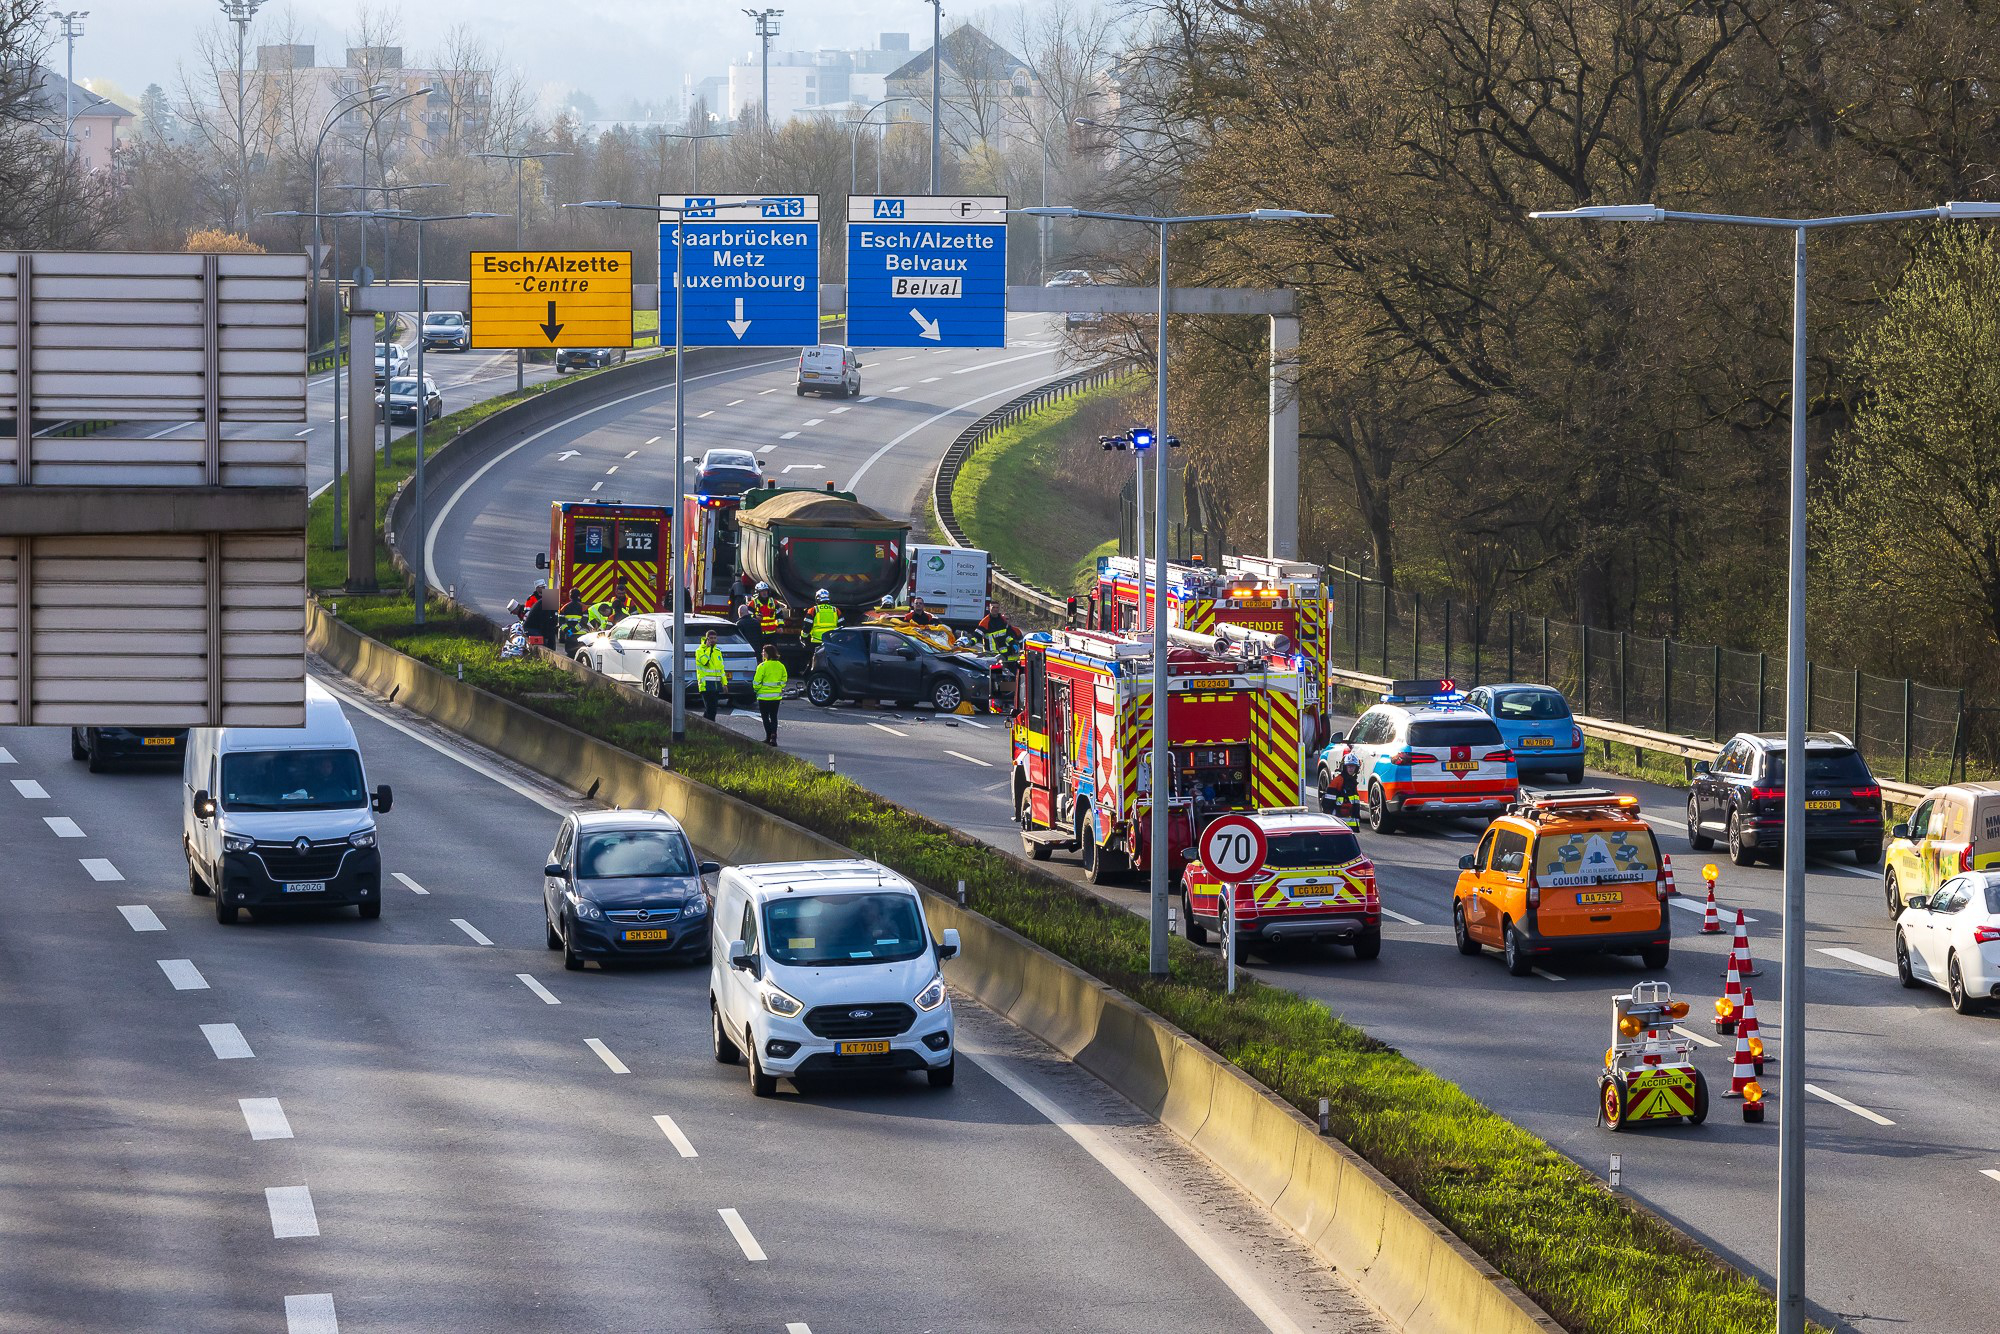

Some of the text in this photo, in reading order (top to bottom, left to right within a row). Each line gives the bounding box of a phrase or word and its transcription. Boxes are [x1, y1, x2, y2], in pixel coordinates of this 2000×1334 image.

[687, 200, 801, 215] A4 A13
[876, 201, 971, 216] A4 F
[671, 230, 807, 246] Saarbrücken
[861, 231, 994, 249] Esch/Alzette
[484, 256, 619, 272] Esch/Alzette
[713, 251, 765, 267] Metz
[886, 254, 967, 271] Belvaux
[515, 276, 589, 292] -Centre
[673, 272, 805, 291] Luxembourg
[896, 279, 958, 295] Belval
[626, 538, 652, 549] 112
[956, 562, 975, 570] Facility
[1808, 801, 1837, 809] EE 2606
[1216, 834, 1250, 865] 70
[1553, 875, 1589, 886] COULOIR
[1298, 886, 1328, 895] CG 1221
[1585, 892, 1618, 902] AA 7572
[630, 931, 662, 939] SM 9301
[846, 1042, 883, 1052] KT 7019
[1641, 1077, 1683, 1087] ACCIDENT
